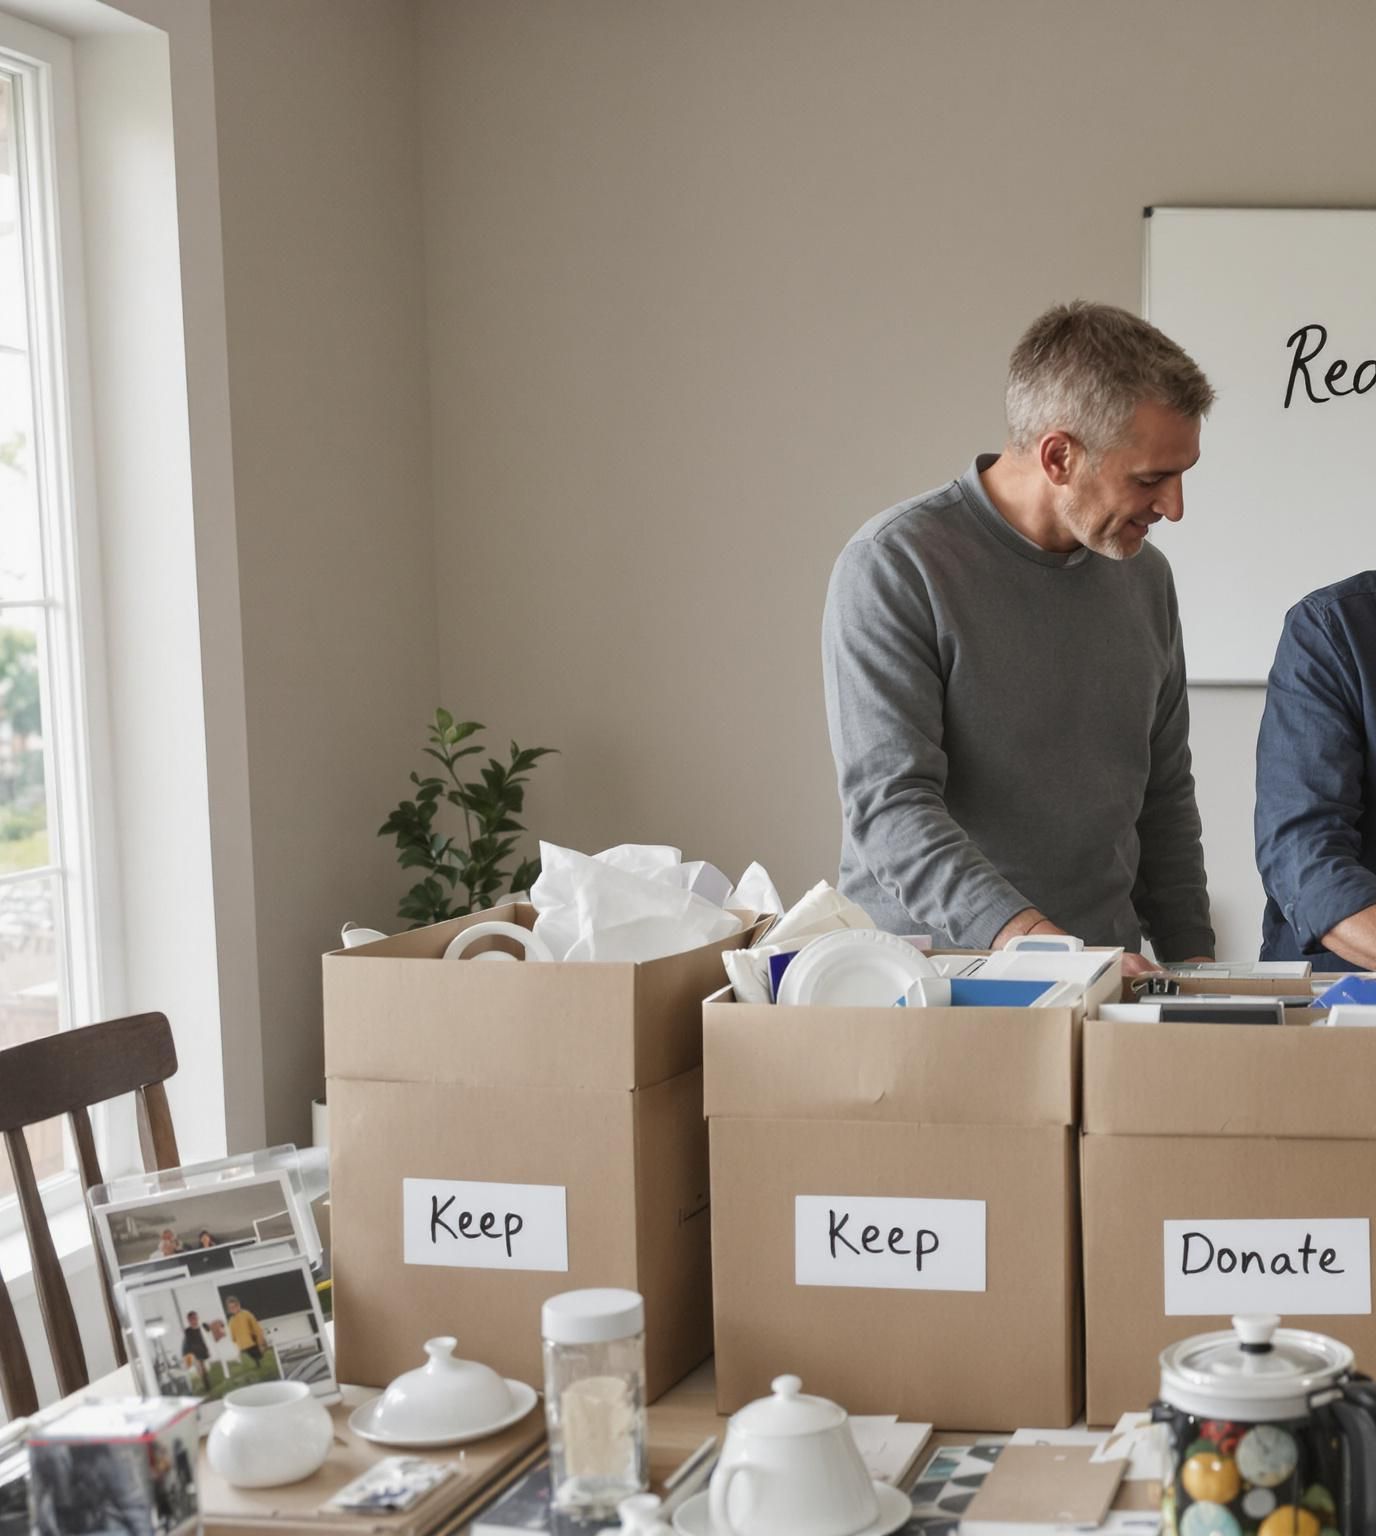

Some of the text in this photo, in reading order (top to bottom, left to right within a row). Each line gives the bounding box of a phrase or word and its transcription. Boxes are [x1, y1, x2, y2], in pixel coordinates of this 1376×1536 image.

[430, 1195, 523, 1258] Keep
[828, 1209, 939, 1272] Keep
[1181, 1232, 1345, 1275] Donate
